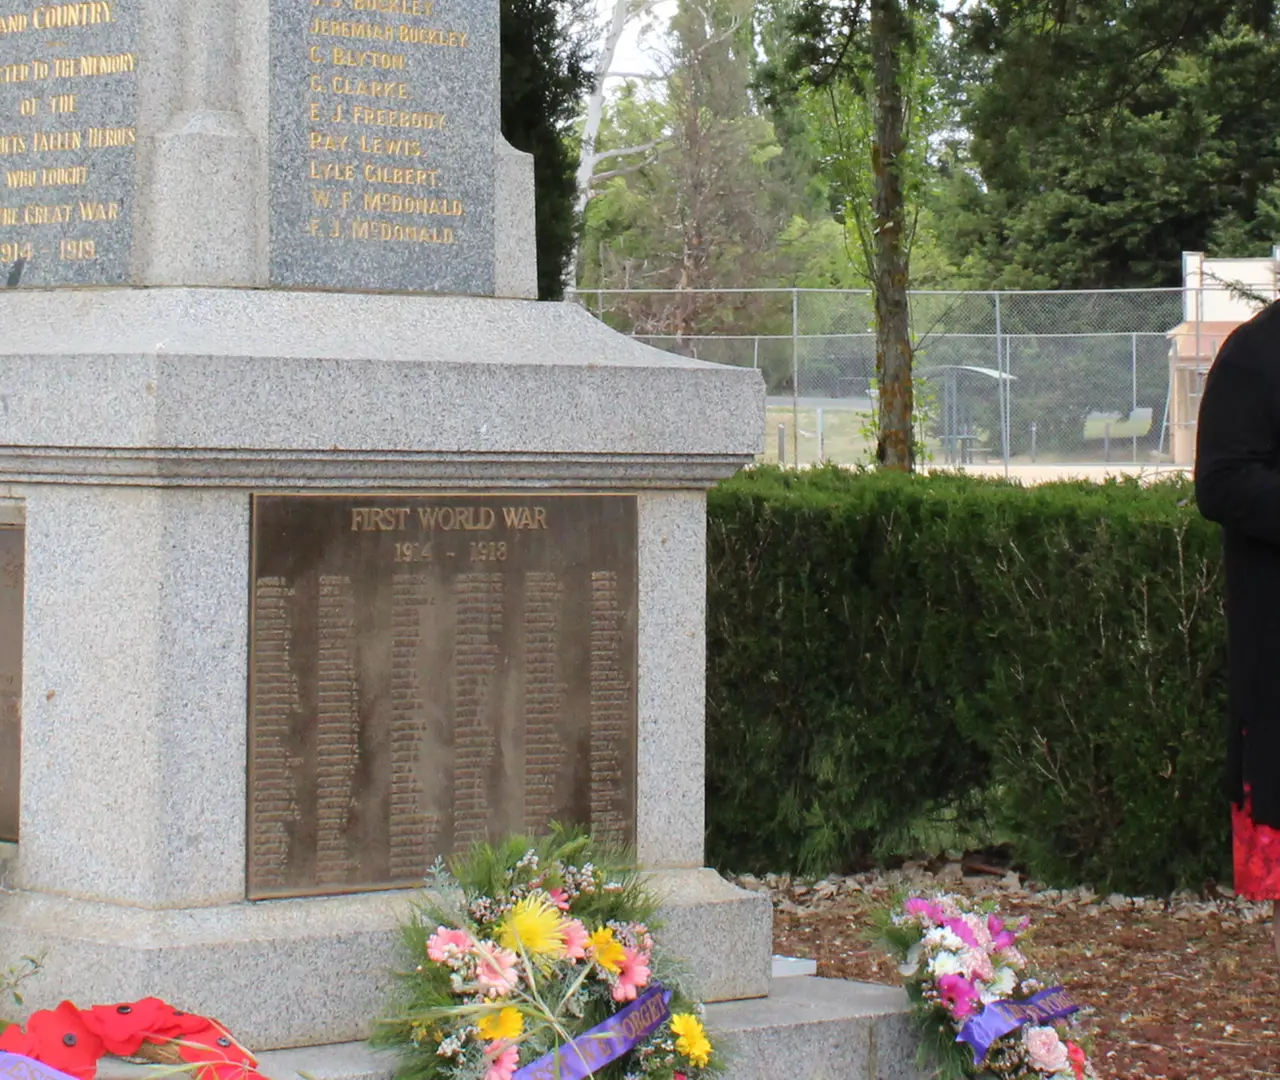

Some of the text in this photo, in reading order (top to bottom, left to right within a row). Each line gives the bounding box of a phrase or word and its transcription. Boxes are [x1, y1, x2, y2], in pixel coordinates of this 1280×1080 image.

[309, 17, 394, 41] JEREMIAH
[32, 59, 49, 80] TO
[53, 57, 79, 78] THE
[80, 52, 134, 76] MEMORY
[21, 93, 78, 115] OF THE
[33, 131, 81, 152] FALLEN
[88, 127, 136, 148] HEROES
[310, 132, 349, 151] RAY
[7, 166, 88, 188] WHO FOUGHT
[310, 160, 356, 181] LYLE
[24, 204, 72, 224] GREAT
[79, 200, 119, 220] WAR
[351, 506, 548, 531] FIRST WORLD WAR
[394, 541, 434, 563] 1914
[469, 541, 508, 562] 1918
[609, 992, 666, 1048] FORGET
